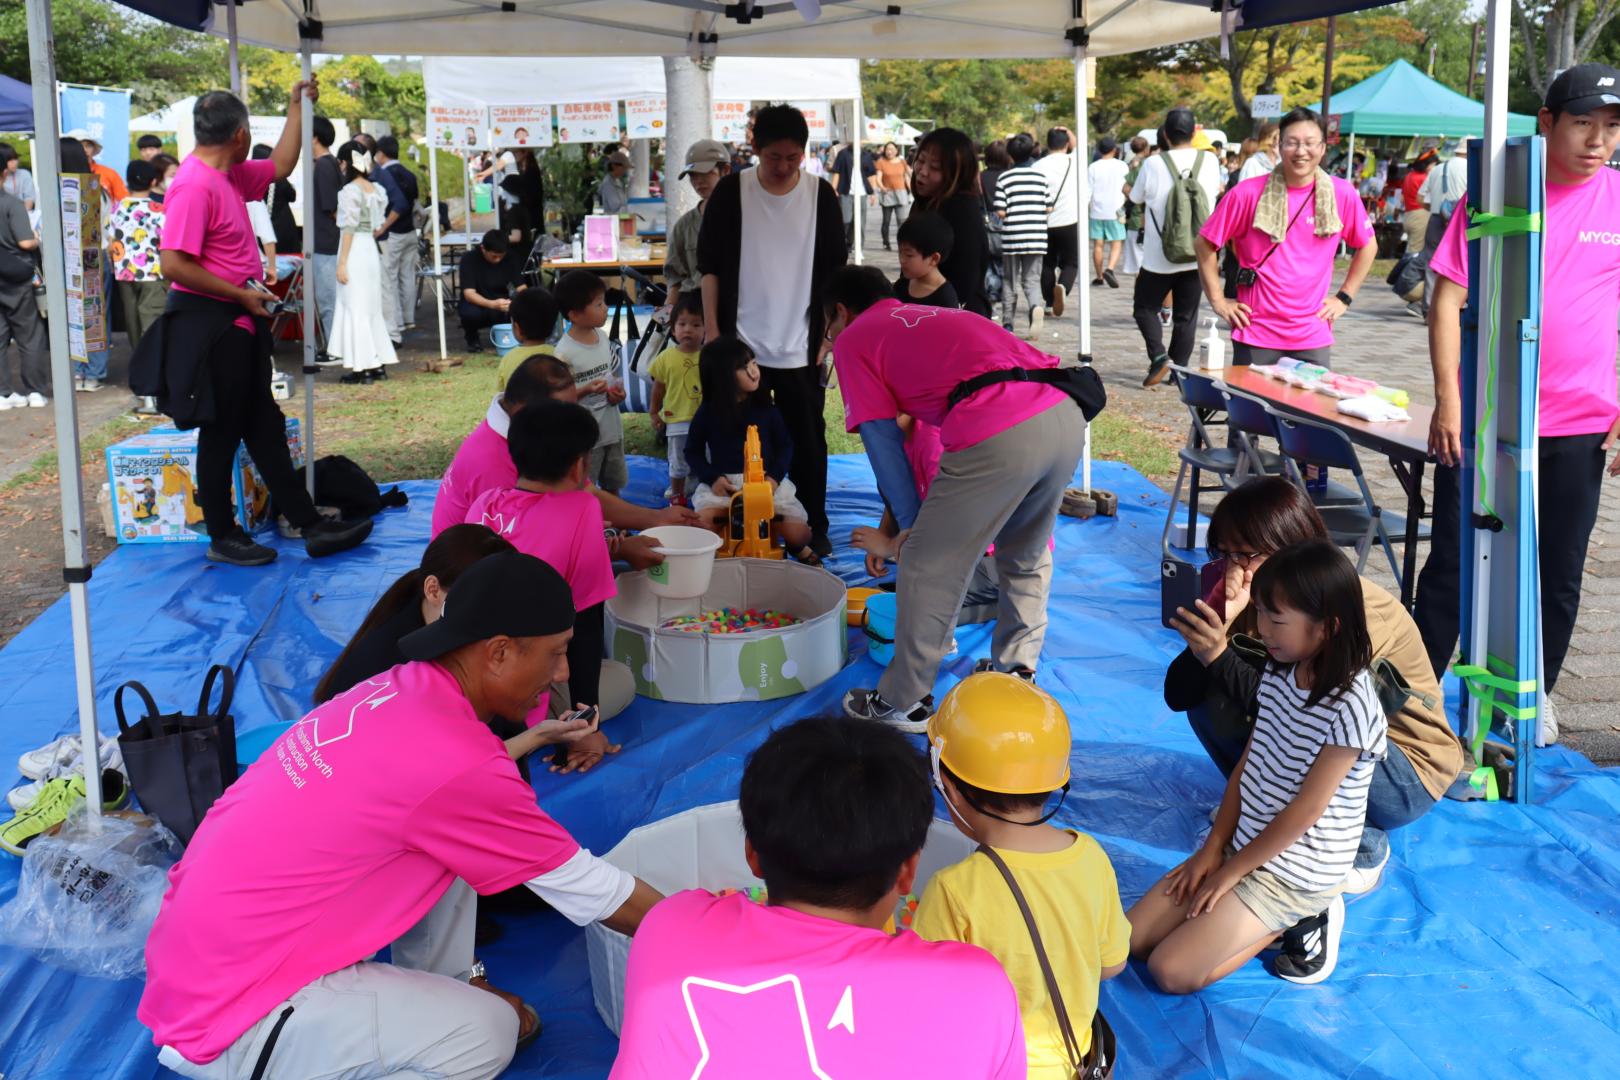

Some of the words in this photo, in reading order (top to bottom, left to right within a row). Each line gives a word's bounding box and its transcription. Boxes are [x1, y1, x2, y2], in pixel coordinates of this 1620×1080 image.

[759, 662, 769, 688] Enjoy
[282, 757, 307, 789] Council
[310, 750, 334, 778] North
